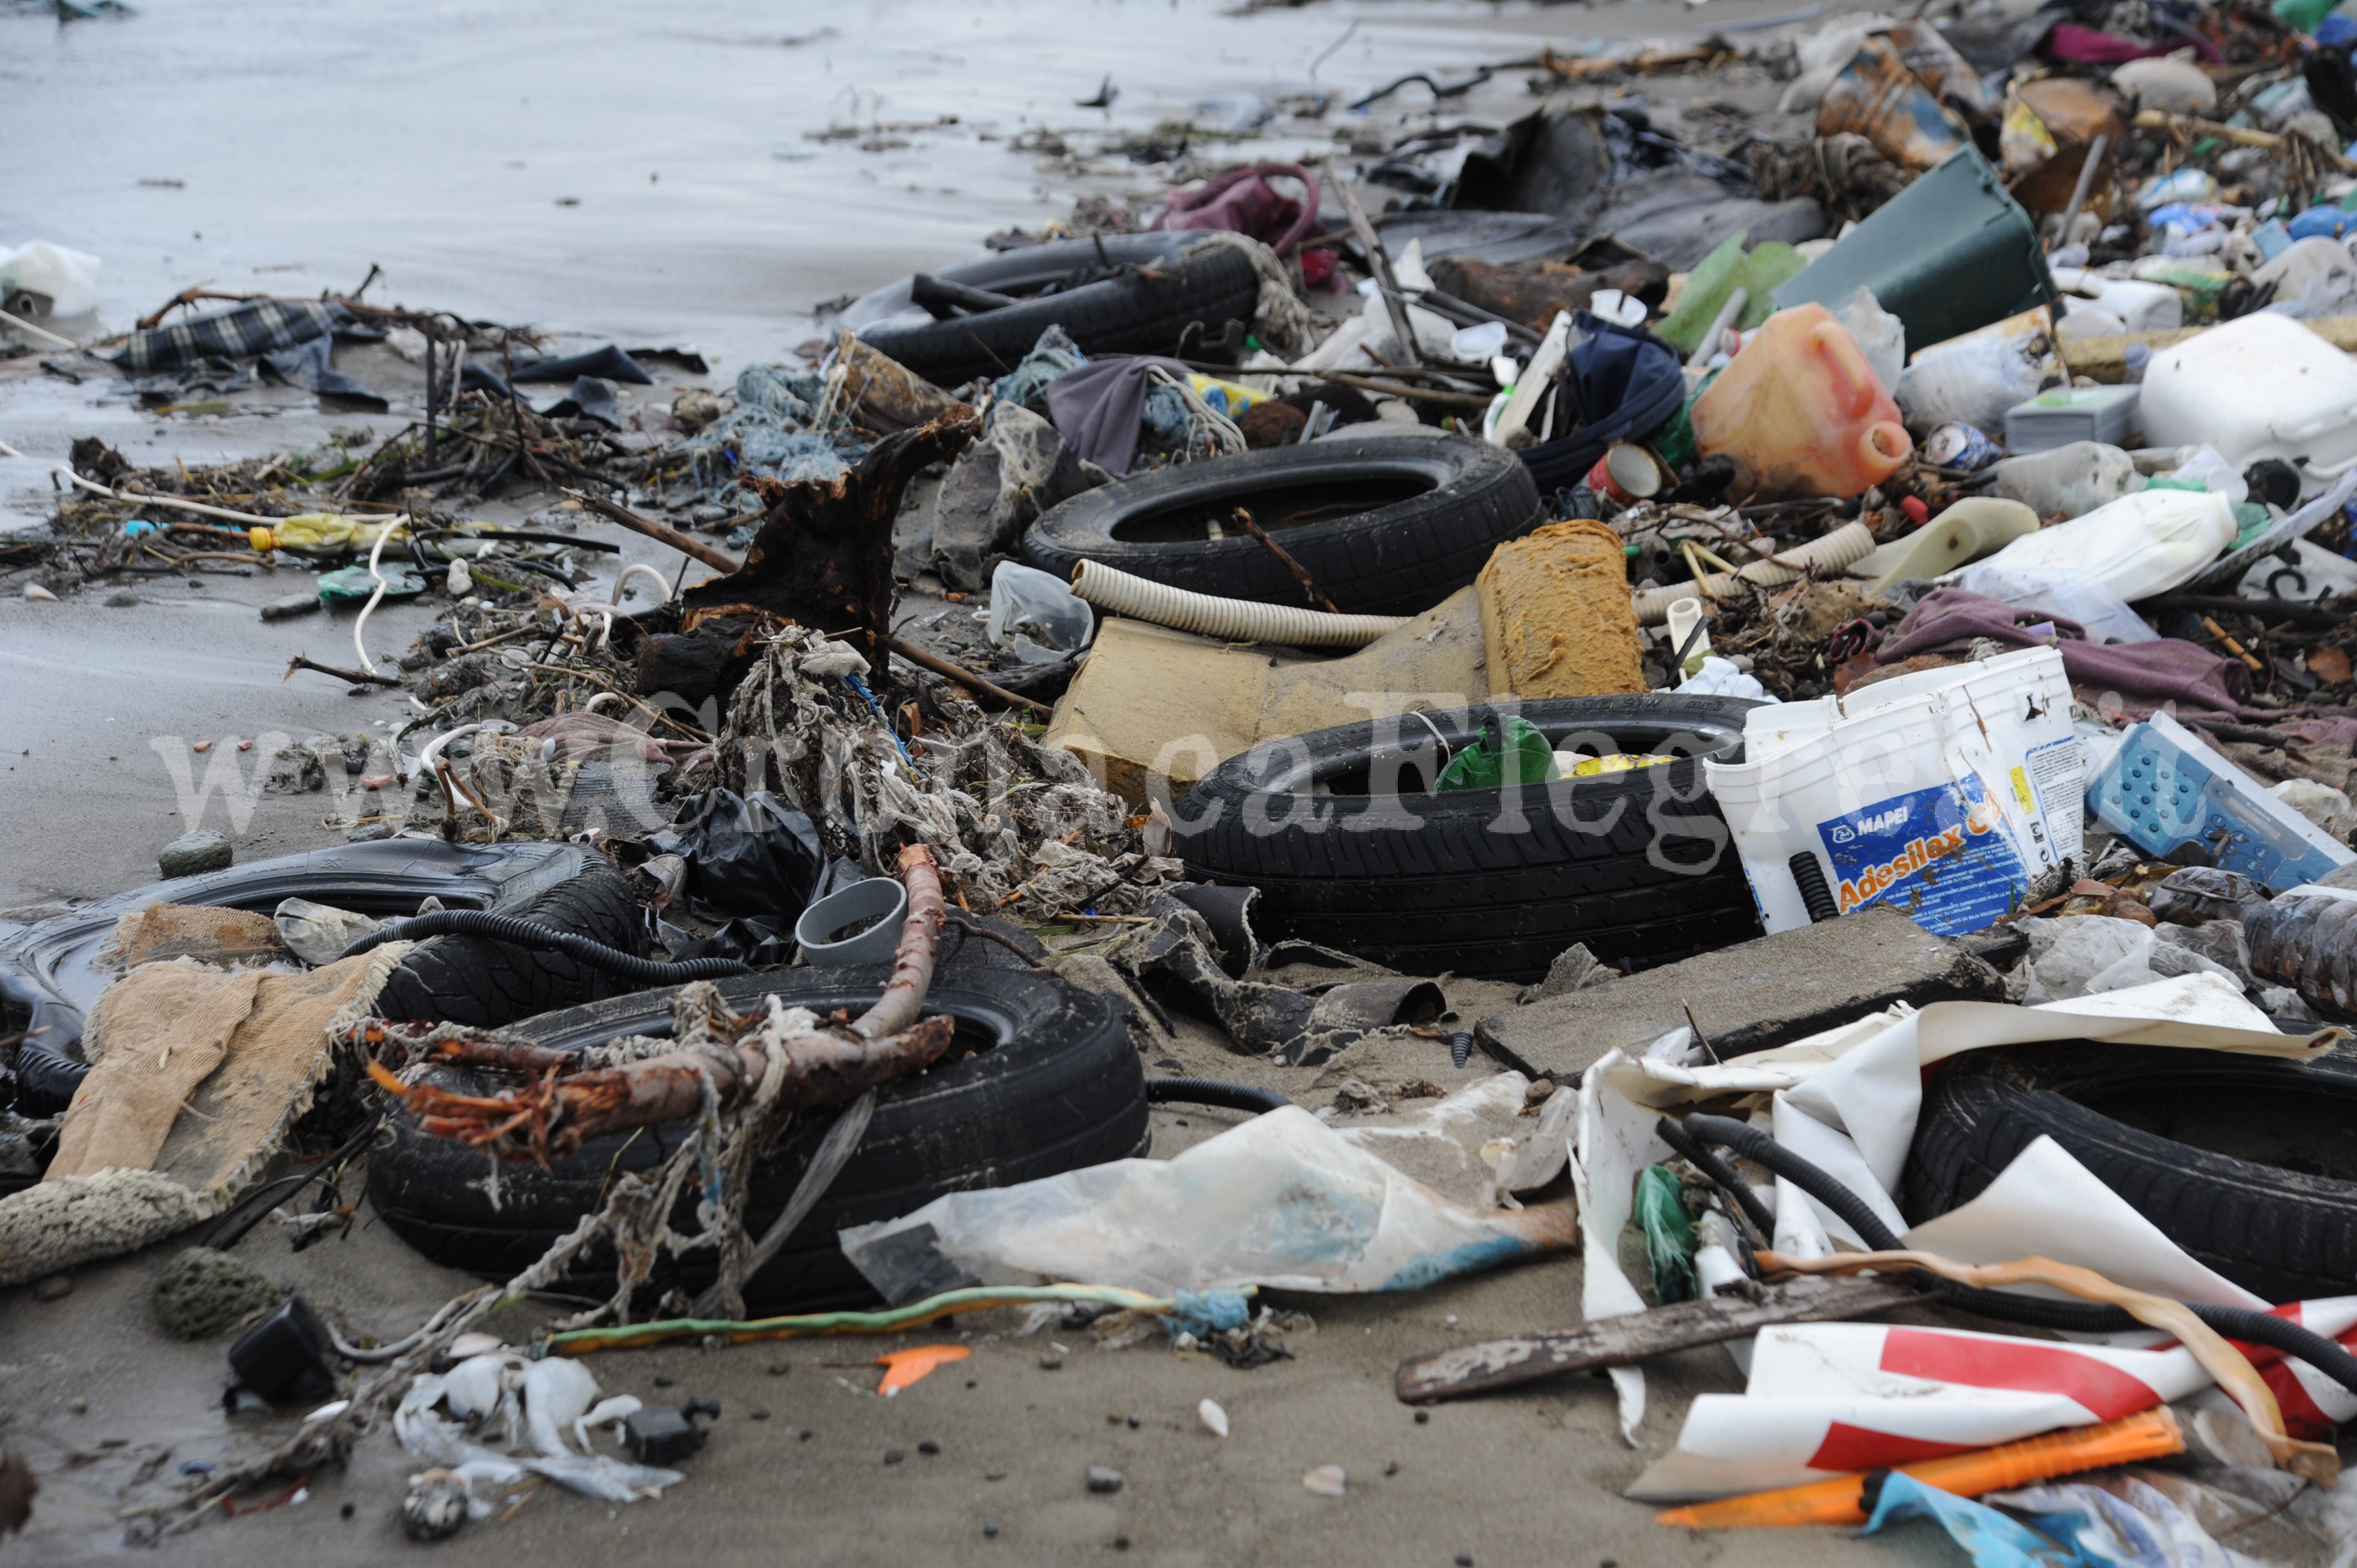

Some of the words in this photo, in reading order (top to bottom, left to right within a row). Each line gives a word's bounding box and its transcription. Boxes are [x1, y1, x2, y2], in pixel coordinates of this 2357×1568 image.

[1858, 806, 1908, 836] MAPEI
[2246, 802, 2271, 822] Canon
[1840, 824, 1967, 913] Adesilax
